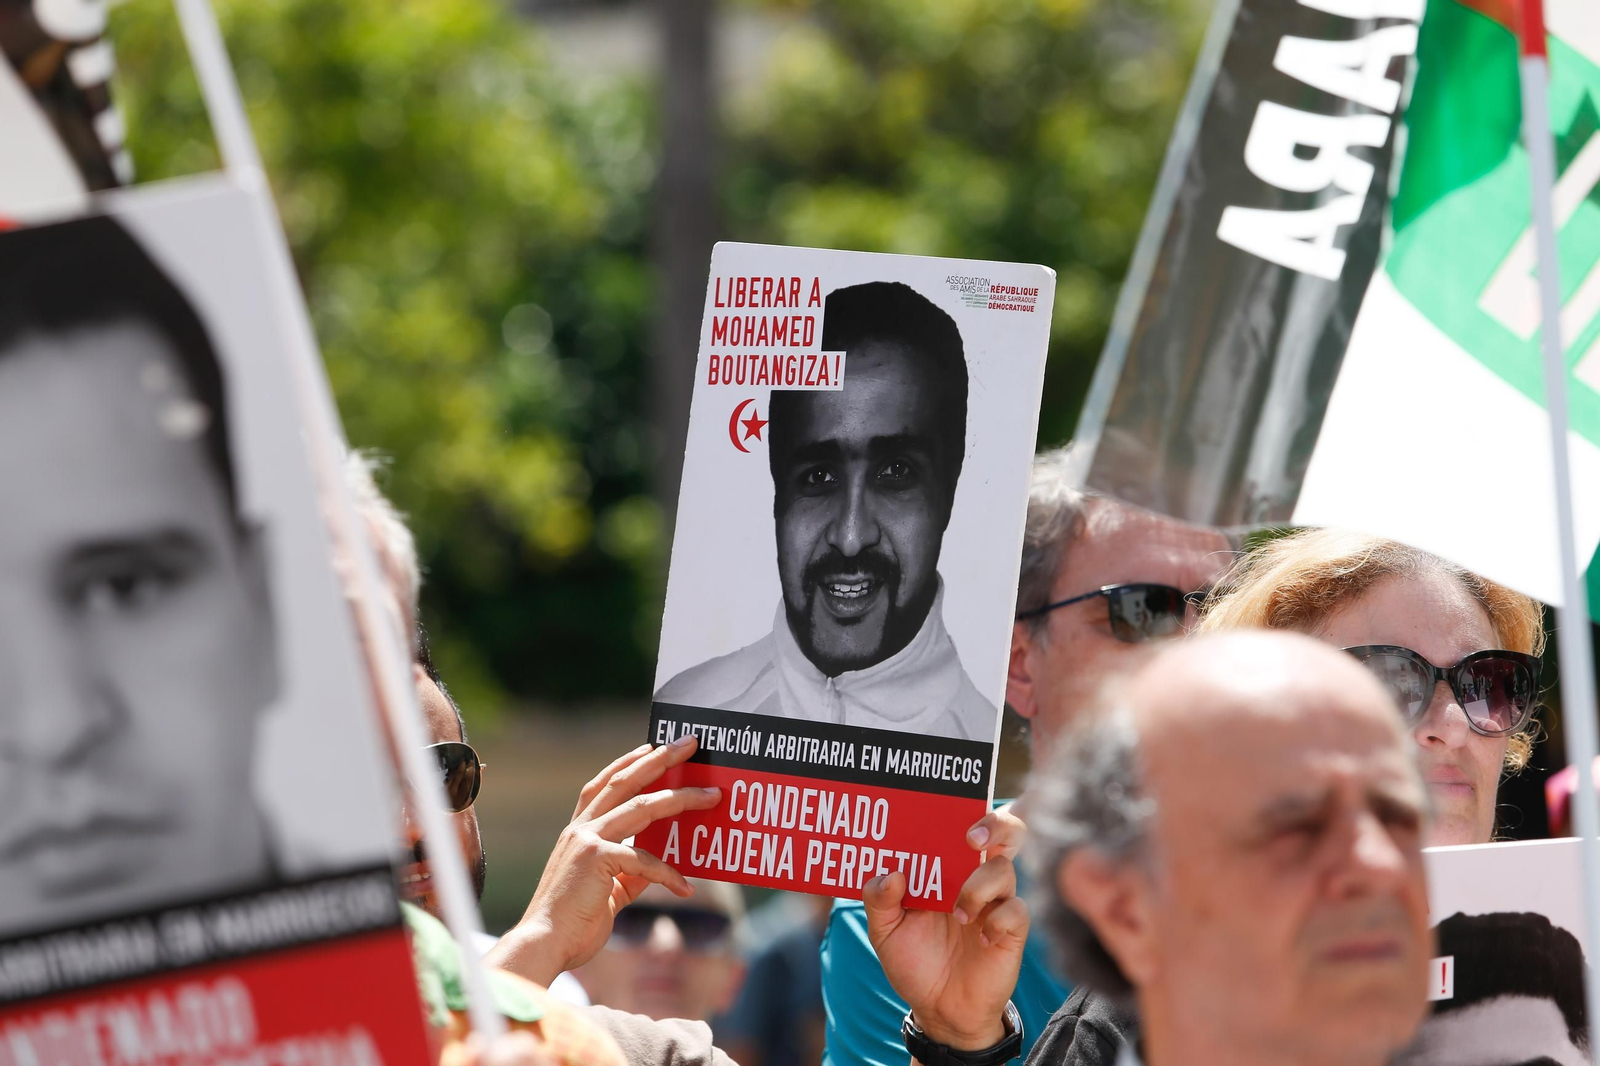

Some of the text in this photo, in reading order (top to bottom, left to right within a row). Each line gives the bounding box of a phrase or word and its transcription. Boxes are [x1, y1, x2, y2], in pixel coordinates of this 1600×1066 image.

[714, 276, 821, 308] LIBERAR A
[945, 275, 991, 287] ASSOCIATION
[959, 285, 976, 294] AMIS
[990, 283, 1039, 297] RÉPUBLIQUE
[988, 301, 1035, 313] DÉMOCRATIQUE
[1007, 295, 1037, 304] SAHRAOUIE
[711, 315, 815, 347] MOHAMED
[708, 354, 840, 387] BOUTANGIZA!
[656, 719, 676, 745] EN
[764, 733, 855, 769] ARBITRARIA
[860, 744, 881, 772] EN
[885, 747, 982, 785] MARRUECOS
[729, 779, 890, 841] CONDENADO
[662, 821, 943, 901] A CADENA PERPETUA
